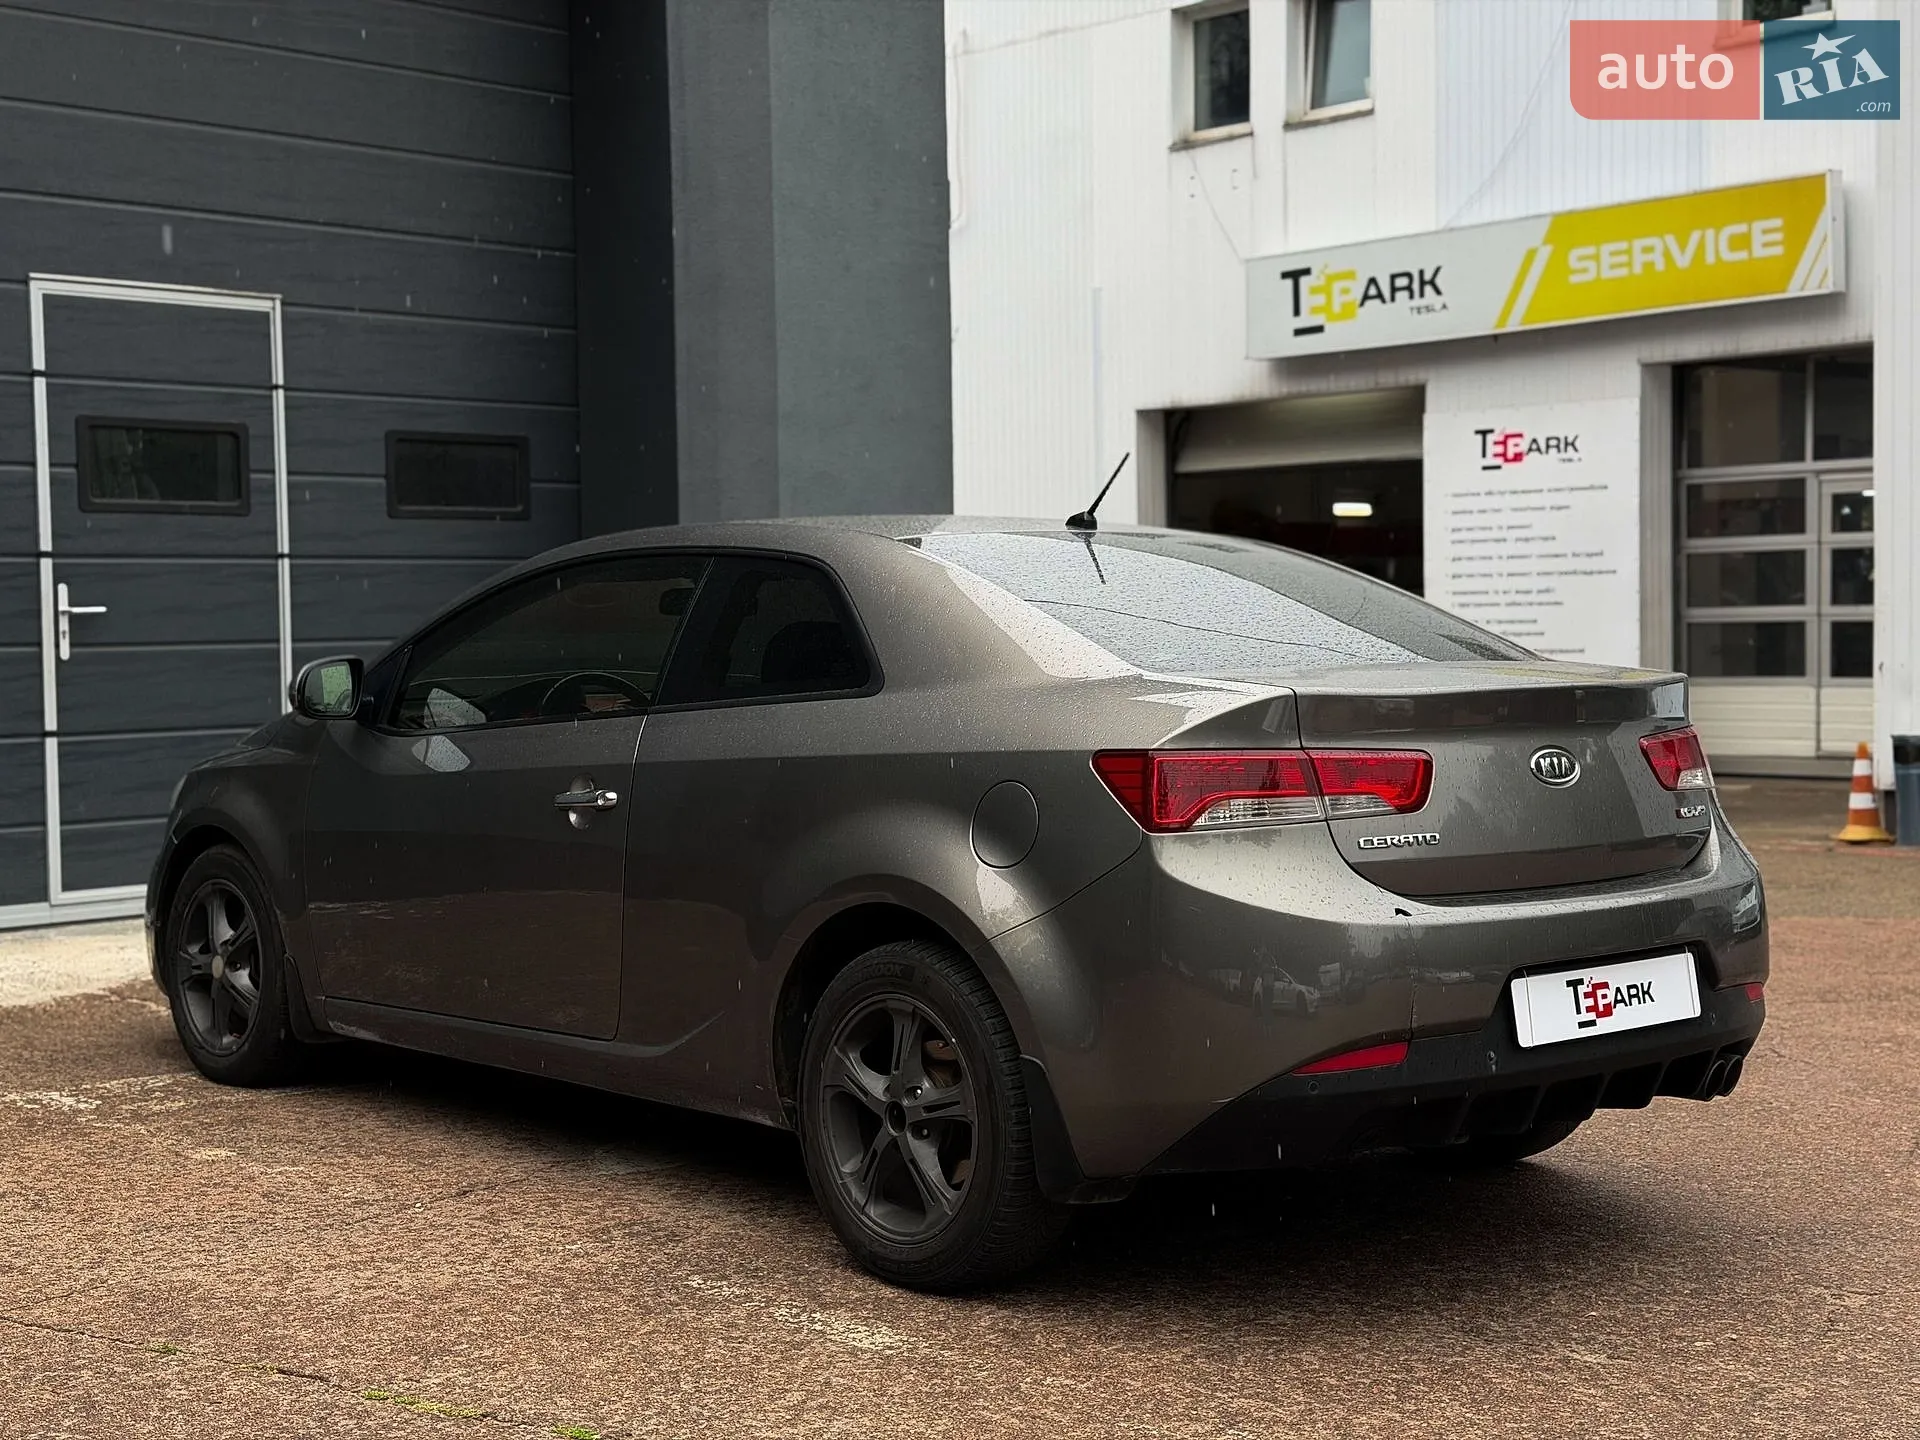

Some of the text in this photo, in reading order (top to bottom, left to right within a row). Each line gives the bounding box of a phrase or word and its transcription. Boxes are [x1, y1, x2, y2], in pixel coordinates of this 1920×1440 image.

[1568, 217, 1785, 284] SERVICE
[1409, 302, 1449, 315] TESLA
[1358, 832, 1440, 849] CERATO
